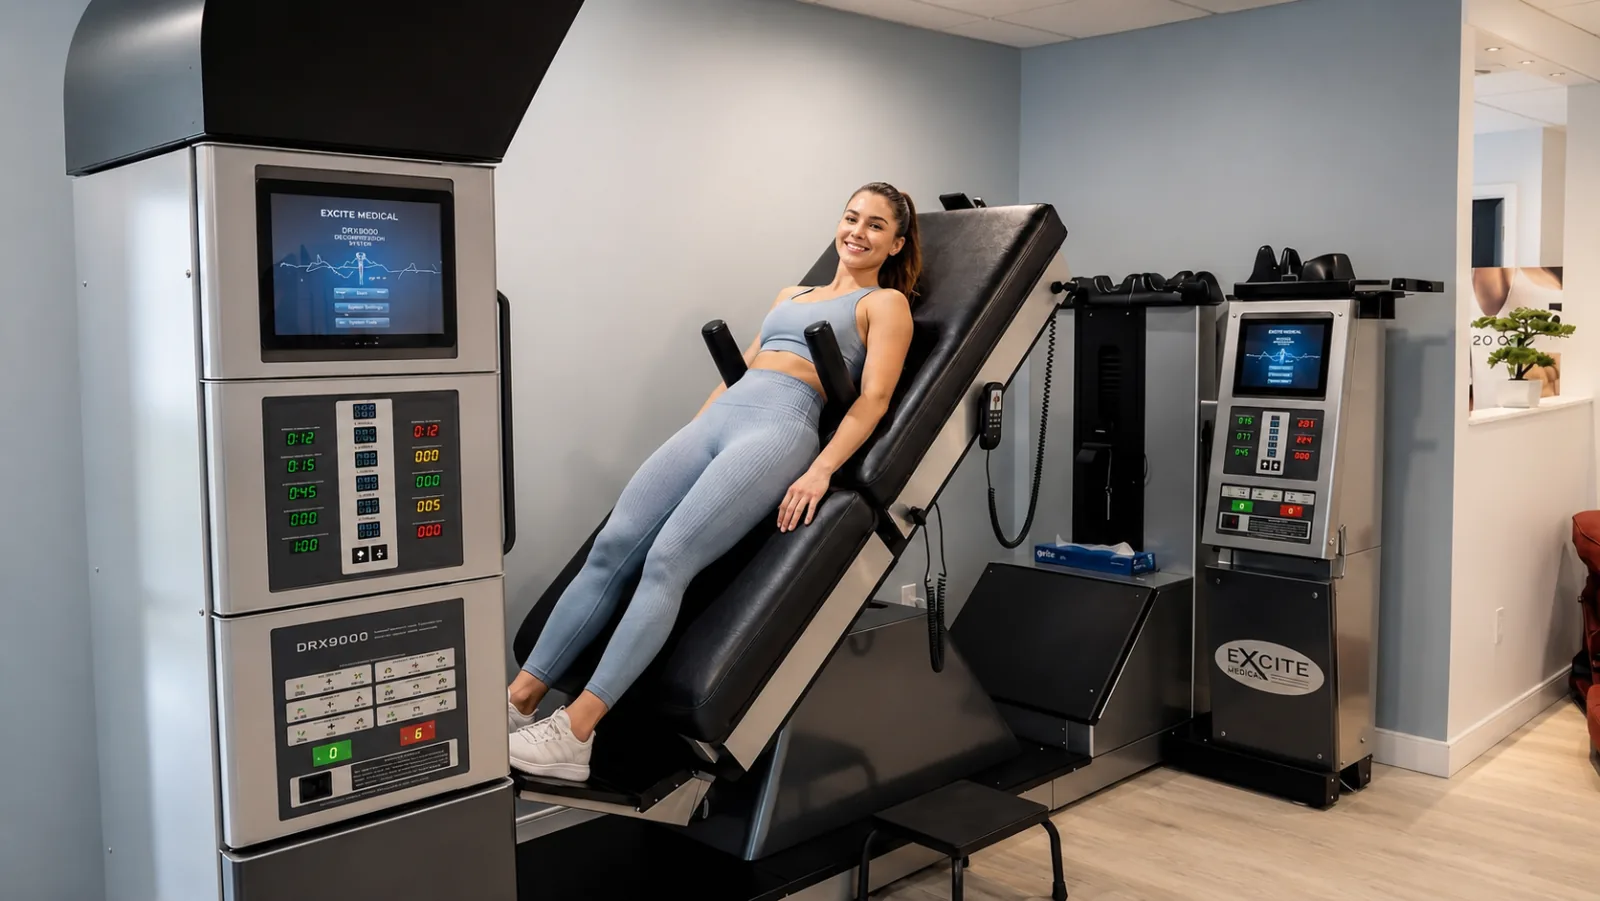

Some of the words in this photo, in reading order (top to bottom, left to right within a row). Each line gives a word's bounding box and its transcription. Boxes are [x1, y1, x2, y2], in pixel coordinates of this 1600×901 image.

[320, 209, 356, 219] EXCITE
[357, 211, 399, 221] MEDICAL
[287, 431, 315, 446] 0:12
[413, 424, 439, 438] 0:12
[414, 449, 440, 463] 000
[287, 458, 315, 473] 0:15
[415, 474, 441, 488] 000
[288, 485, 317, 500] 0:45
[416, 498, 441, 513] 005
[290, 511, 318, 527] 000
[417, 523, 442, 539] 000
[293, 538, 318, 553] 1:00
[296, 631, 369, 653] DRX9000
[1227, 647, 1309, 681] EXCITE
[414, 727, 422, 740] 6
[329, 746, 338, 760] 0
